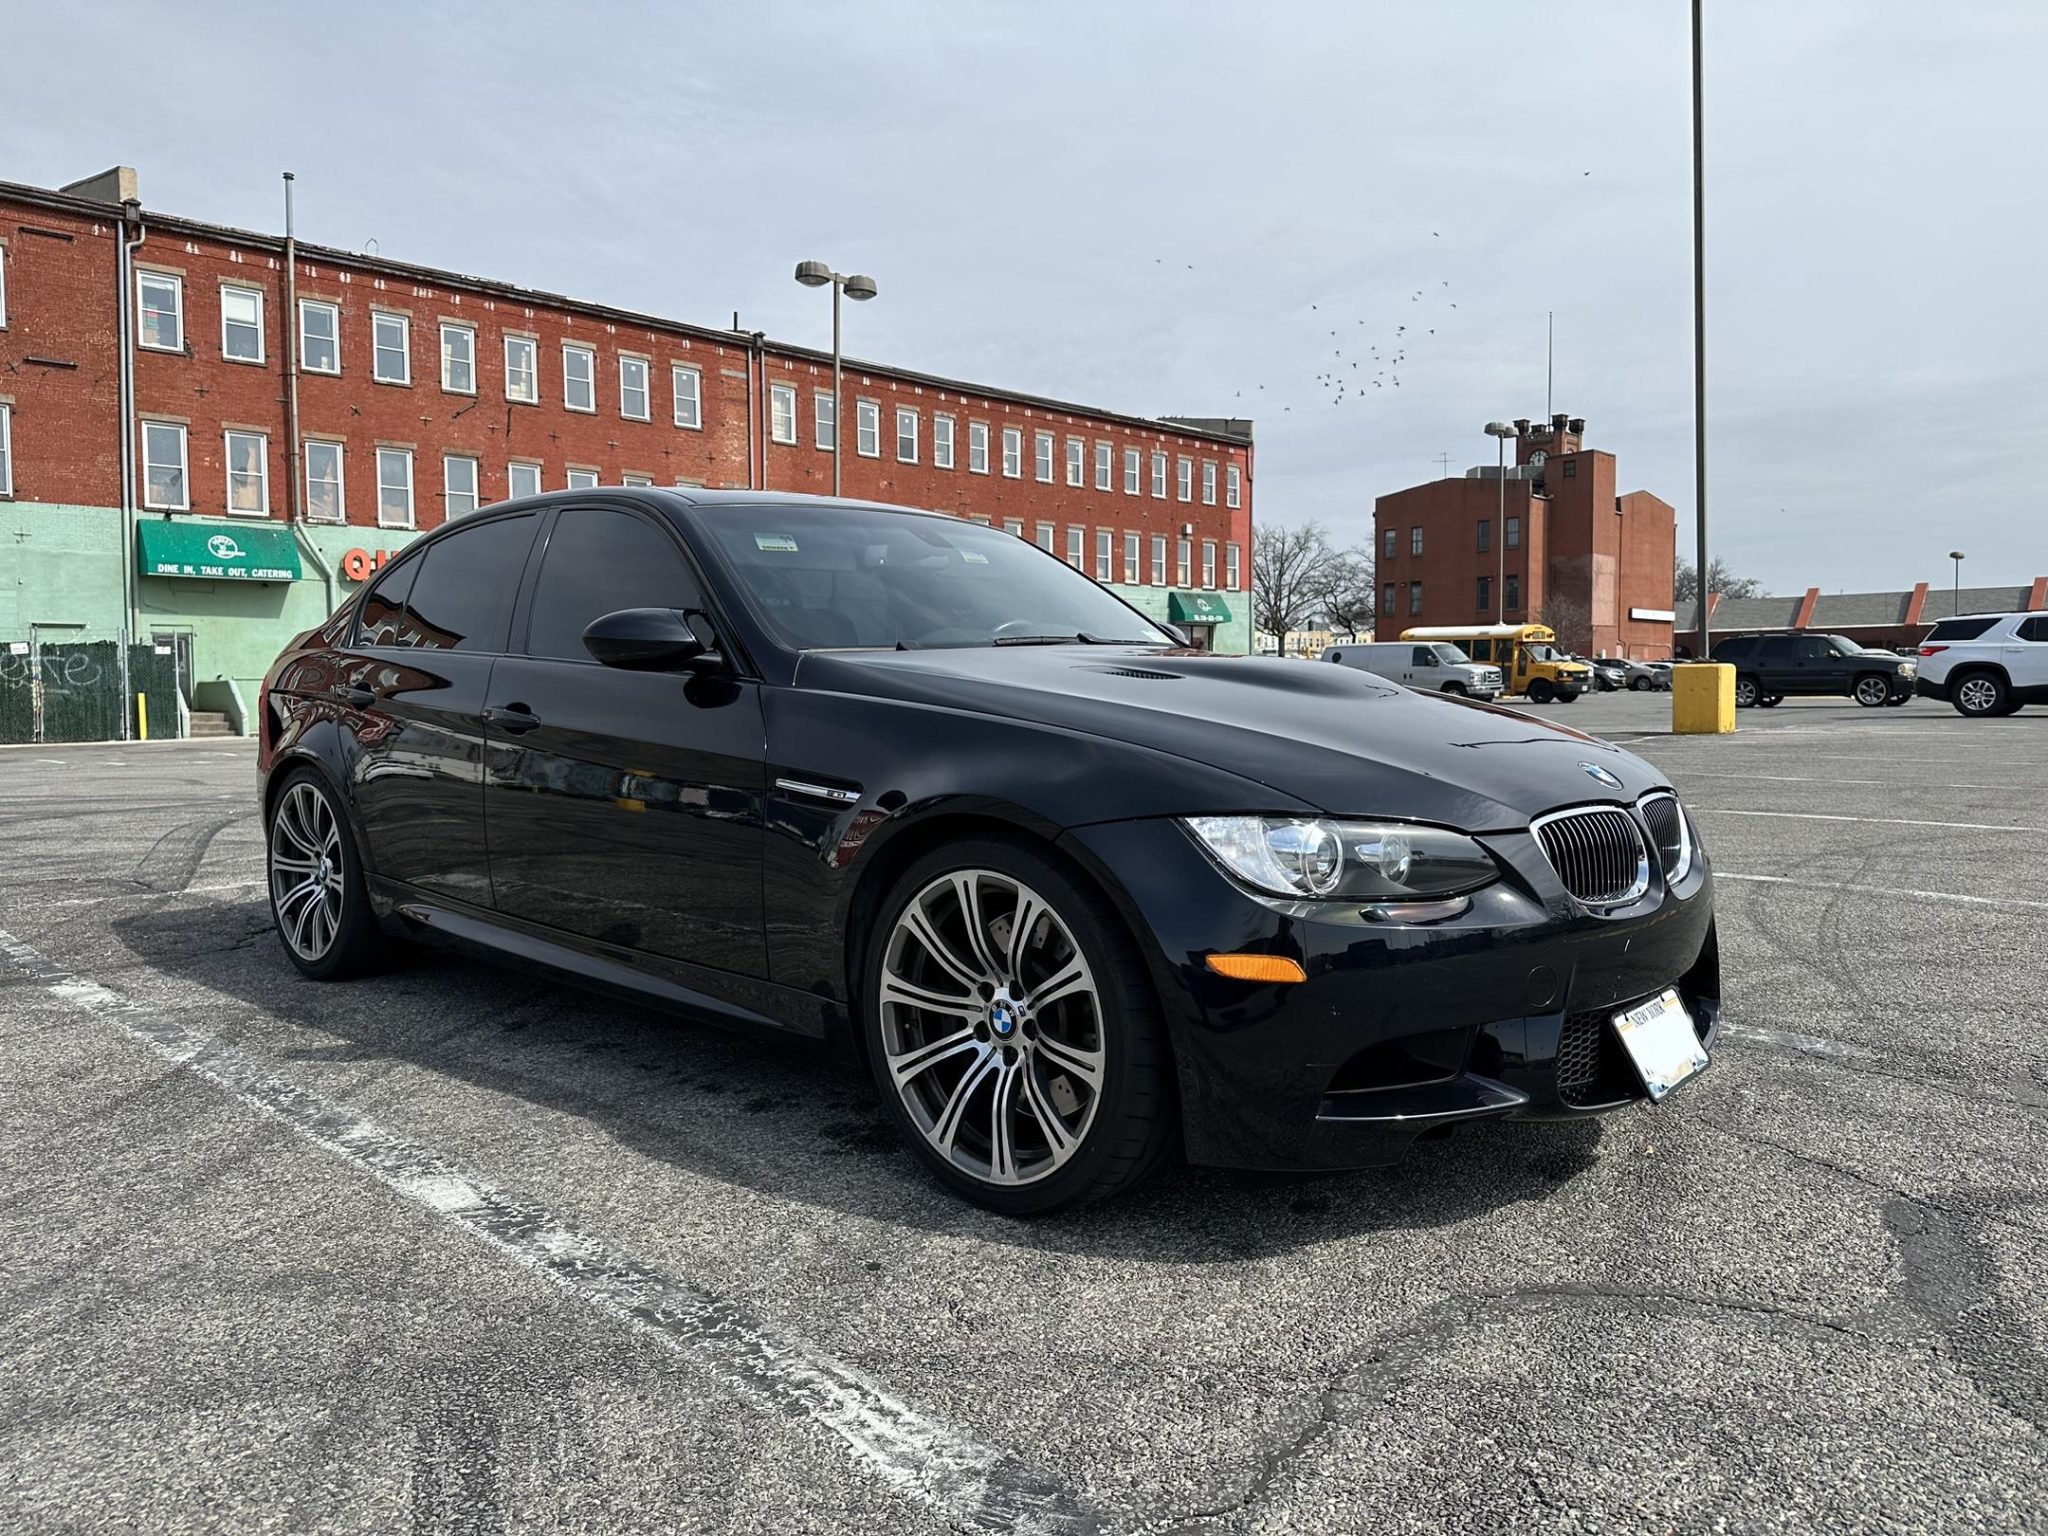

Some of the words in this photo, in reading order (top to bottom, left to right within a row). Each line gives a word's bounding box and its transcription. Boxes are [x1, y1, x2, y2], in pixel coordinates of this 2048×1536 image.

[157, 563, 180, 574] DINE
[183, 564, 196, 576] IN,
[200, 566, 224, 577] TAKE
[227, 567, 248, 578] OUT,
[251, 568, 293, 579] CATERING
[991, 1001, 1016, 1017] BMW
[1630, 1009, 1650, 1028] NEW
